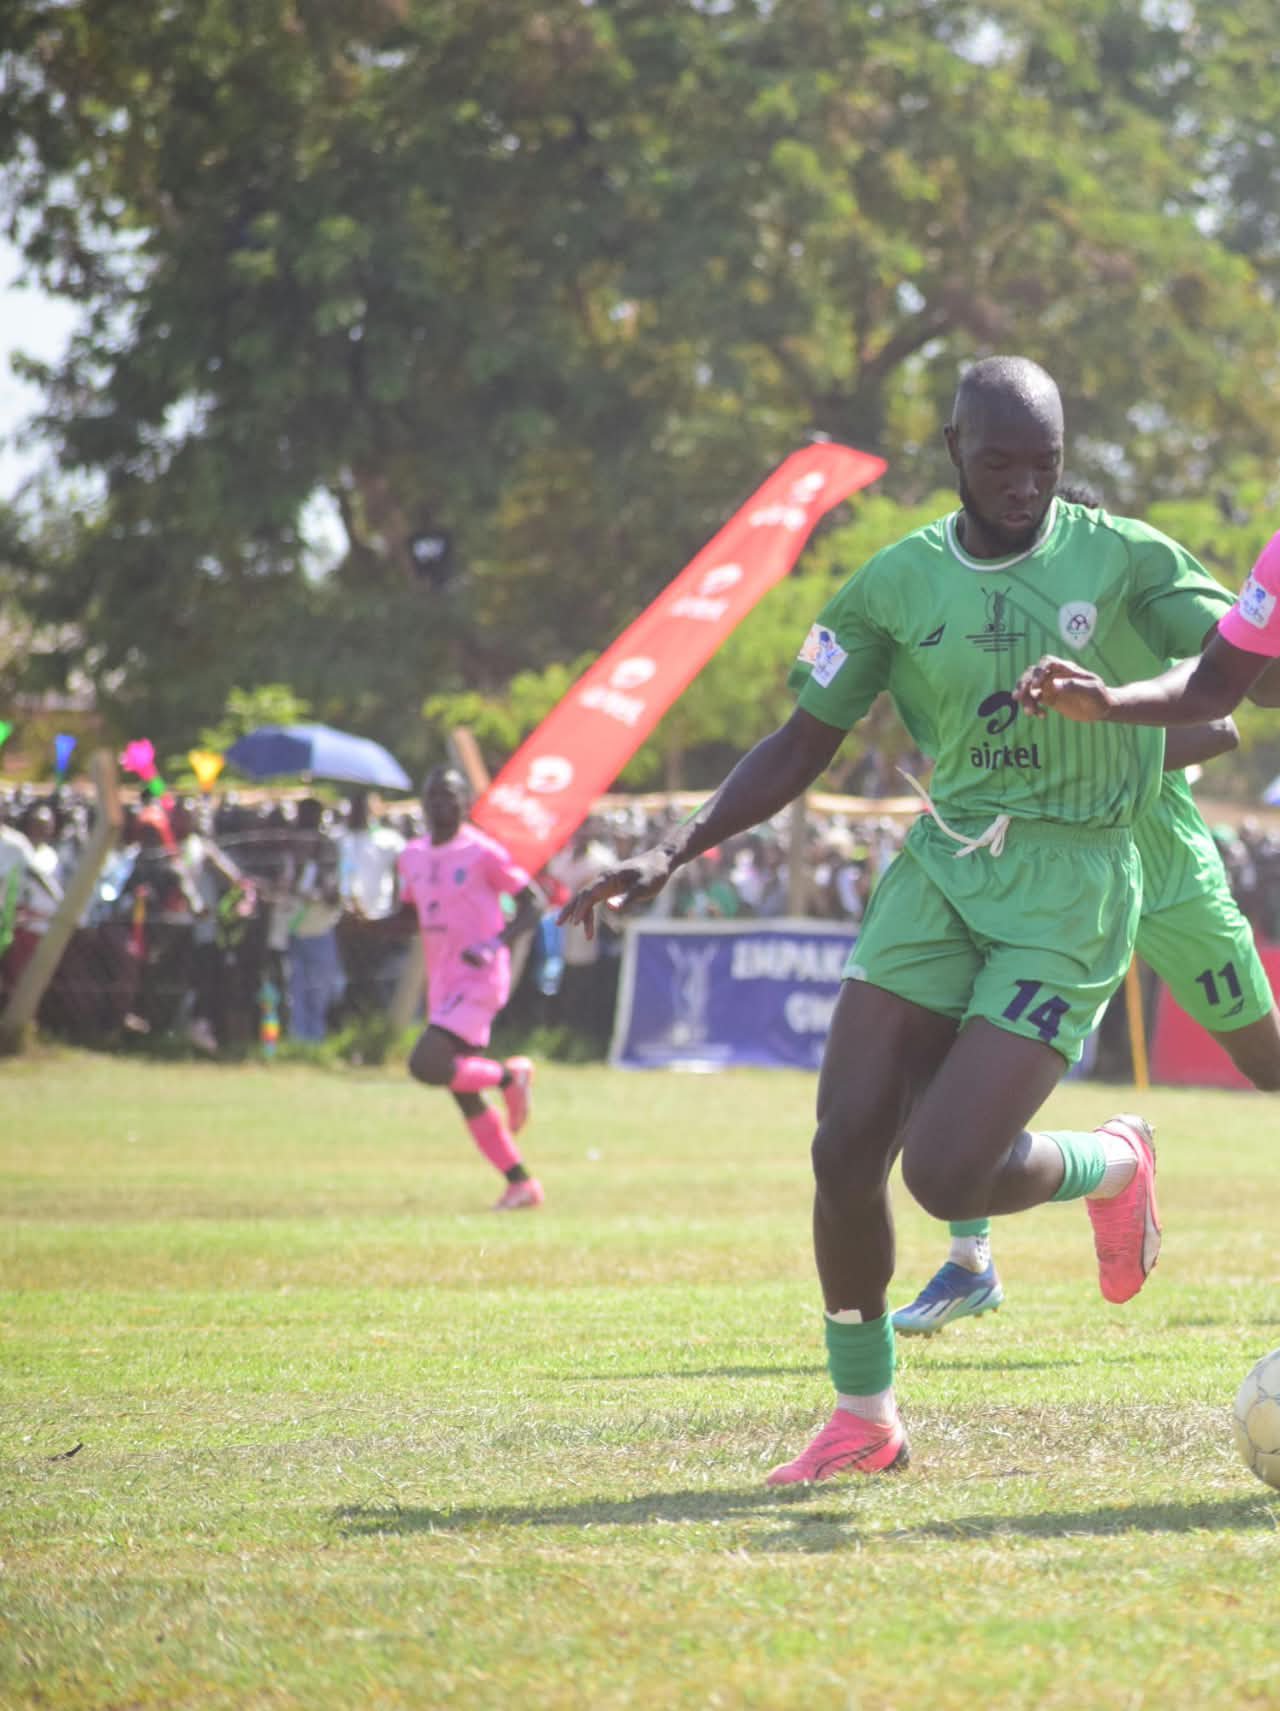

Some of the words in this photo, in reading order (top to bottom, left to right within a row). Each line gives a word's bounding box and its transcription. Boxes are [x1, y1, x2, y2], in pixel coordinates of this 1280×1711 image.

[971, 742, 1041, 770] airtel
[1195, 961, 1241, 1005] 11
[1001, 979, 1071, 1041] 14
